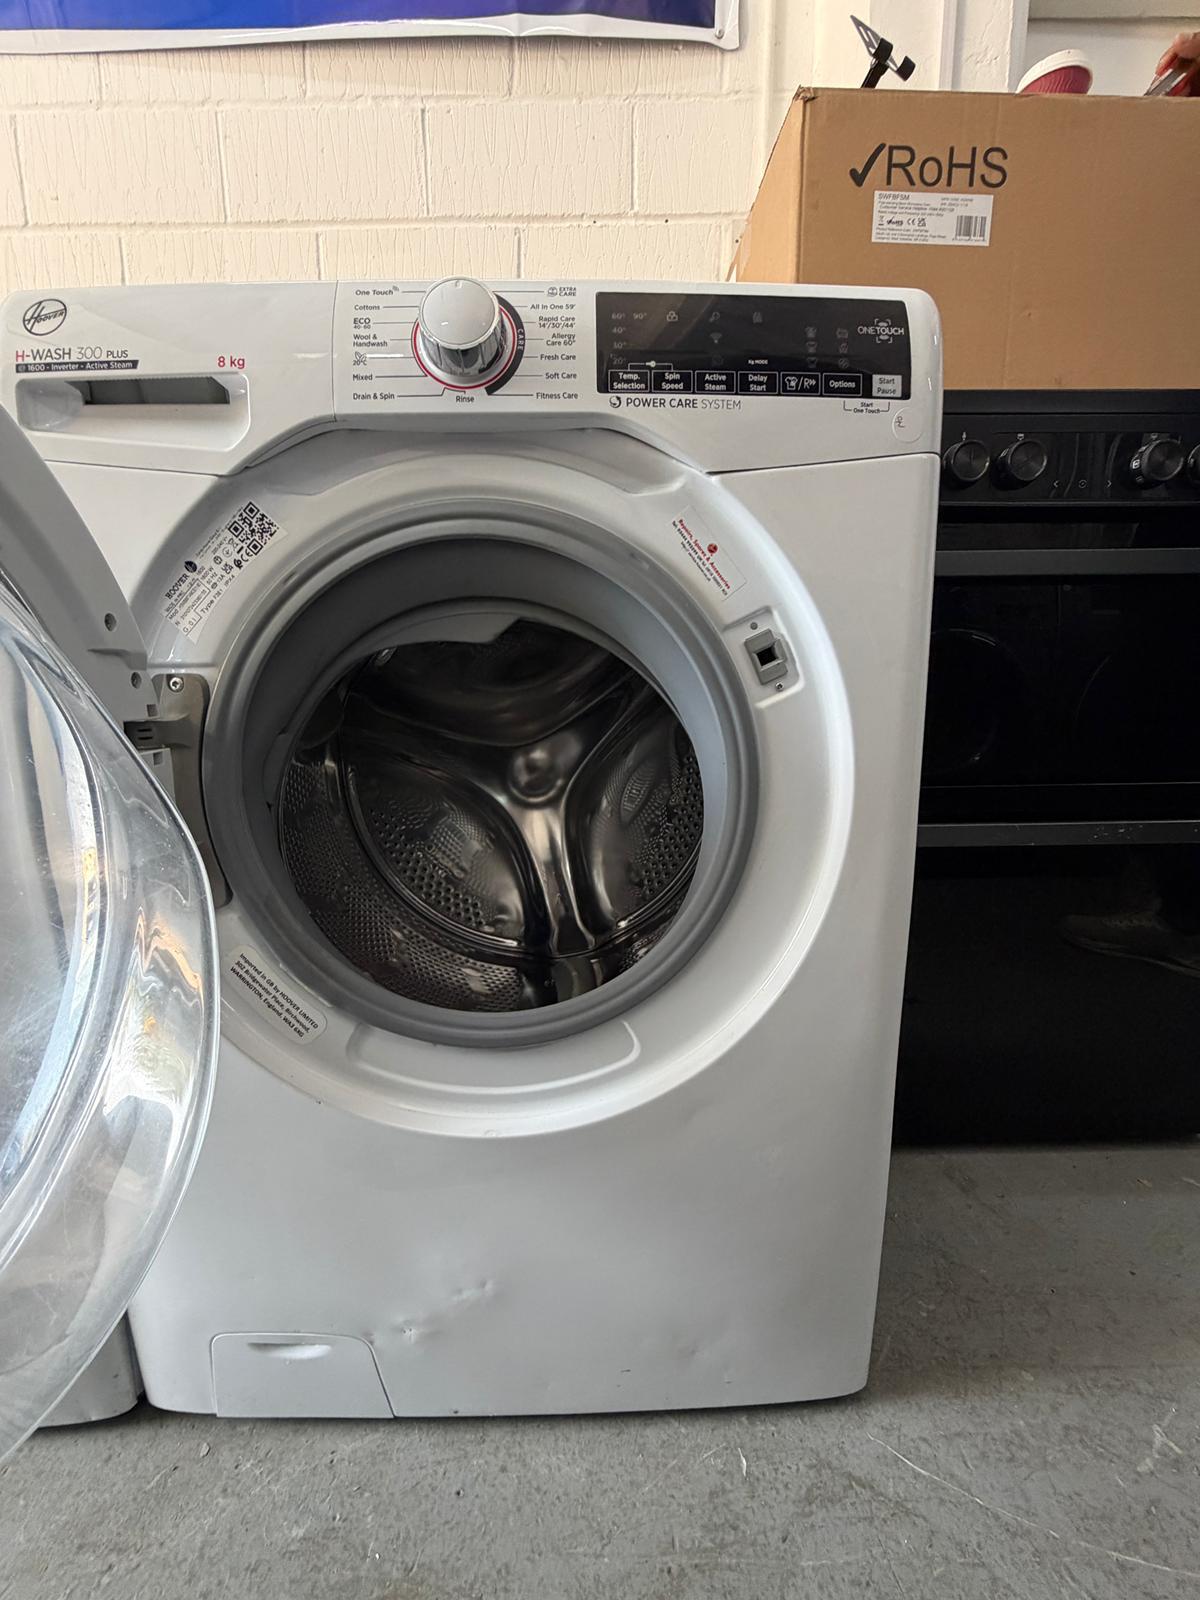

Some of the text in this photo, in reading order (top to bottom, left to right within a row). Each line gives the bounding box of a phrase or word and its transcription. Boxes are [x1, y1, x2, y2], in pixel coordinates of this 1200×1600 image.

[886, 145, 1008, 188] RoHS
[16, 346, 128, 362] H-WASH 300 PLUS
[28, 364, 46, 372] 1600
[52, 362, 78, 370] Inverter
[86, 361, 108, 370] Active
[110, 360, 132, 368] Steam
[218, 356, 245, 370] 8 kg
[546, 372, 560, 380] Soft
[618, 373, 640, 381] Temp.
[664, 373, 680, 382] Spin
[748, 374, 768, 382] Delay
[612, 382, 646, 390] Selection
[661, 382, 684, 391] Speed
[704, 383, 726, 391] Steam
[829, 380, 856, 388] Options
[877, 387, 896, 395] Pause
[352, 392, 372, 400] Drain
[380, 392, 395, 400] Spin
[536, 392, 578, 400] Fitness Care
[626, 398, 742, 410] POWER CARE SYSTEM
[164, 573, 189, 599] HOOVER
[200, 599, 214, 613] Type
[230, 966, 262, 999] WARRINGTON,
[263, 998, 282, 1017] England,
[239, 953, 262, 975] Imported
[279, 991, 299, 1011] HOOVER
[298, 1010, 318, 1028] LIMITED
[244, 969, 272, 995] Bridgewater
[271, 994, 284, 1009] Place,
